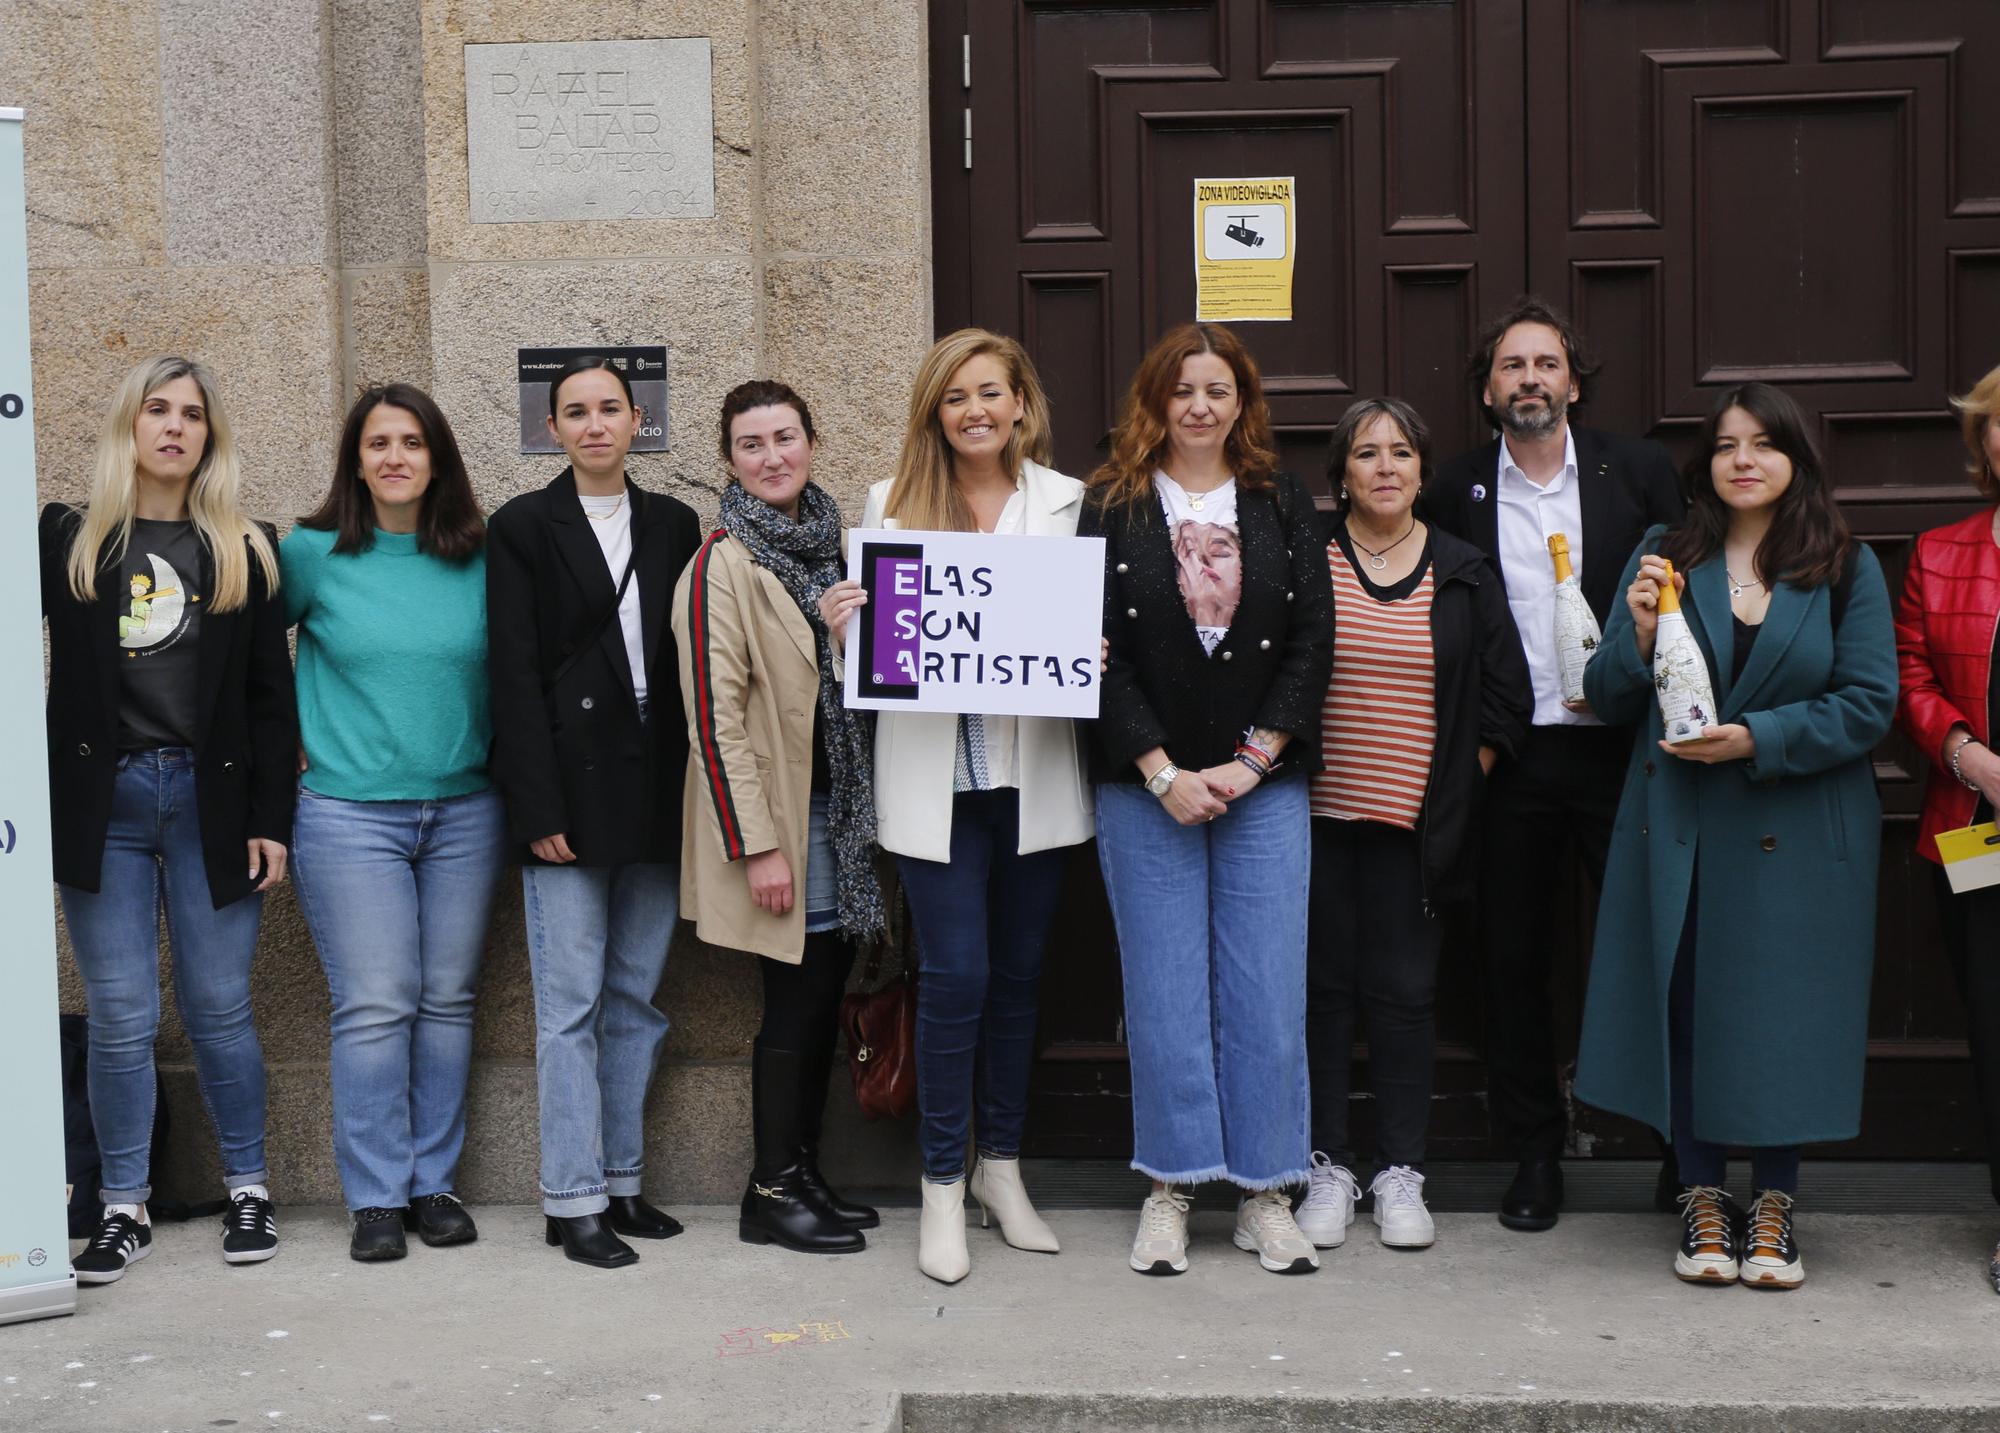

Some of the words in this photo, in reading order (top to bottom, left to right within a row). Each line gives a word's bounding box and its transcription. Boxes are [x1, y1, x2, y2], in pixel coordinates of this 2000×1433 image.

[491, 70, 655, 109] RAFAEL
[515, 112, 661, 150] BALTAR
[625, 189, 701, 215] 2004
[1199, 186, 1222, 201] ZONA
[1224, 184, 1290, 201] VIDEOVIGILADA
[894, 563, 993, 597] ELAS
[894, 608, 981, 642] SON
[895, 650, 1093, 688] ARTISTAS
